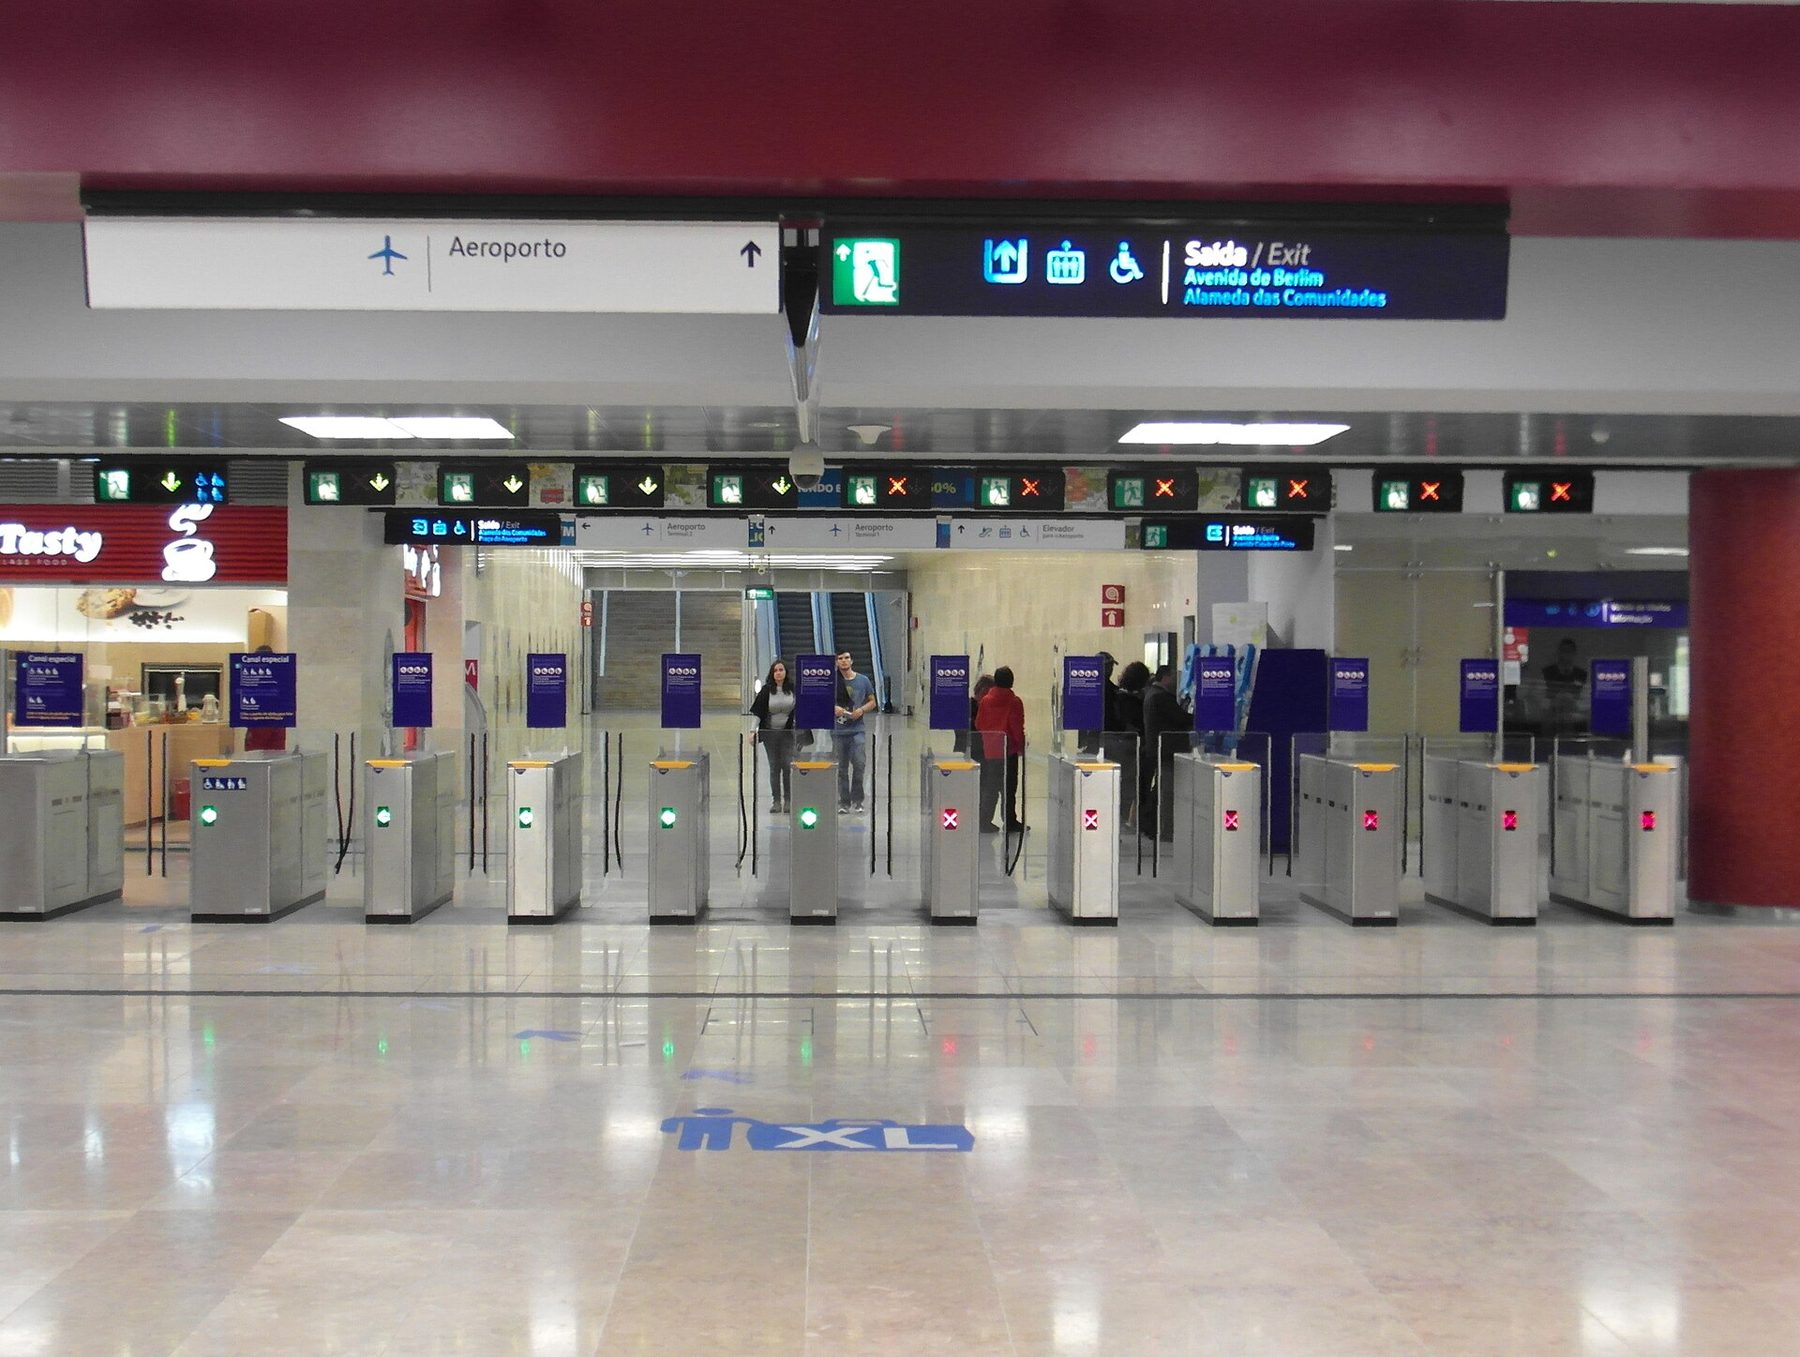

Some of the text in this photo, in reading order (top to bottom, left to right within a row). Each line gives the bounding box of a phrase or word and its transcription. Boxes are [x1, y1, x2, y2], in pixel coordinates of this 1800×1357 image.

[449, 236, 567, 263] Aeroporto
[1267, 242, 1312, 266] Exit
[1184, 268, 1324, 288] Avenida de Berlim
[1184, 288, 1387, 308] Alameda das Comunidades
[667, 522, 705, 532] Aeroporto
[855, 523, 893, 533] Aeroporto
[1042, 525, 1075, 533] Elevador
[0, 523, 103, 563] Tasty
[28, 655, 76, 664] Canal especial
[241, 655, 290, 665] Canal especial
[773, 1126, 959, 1149] XL
